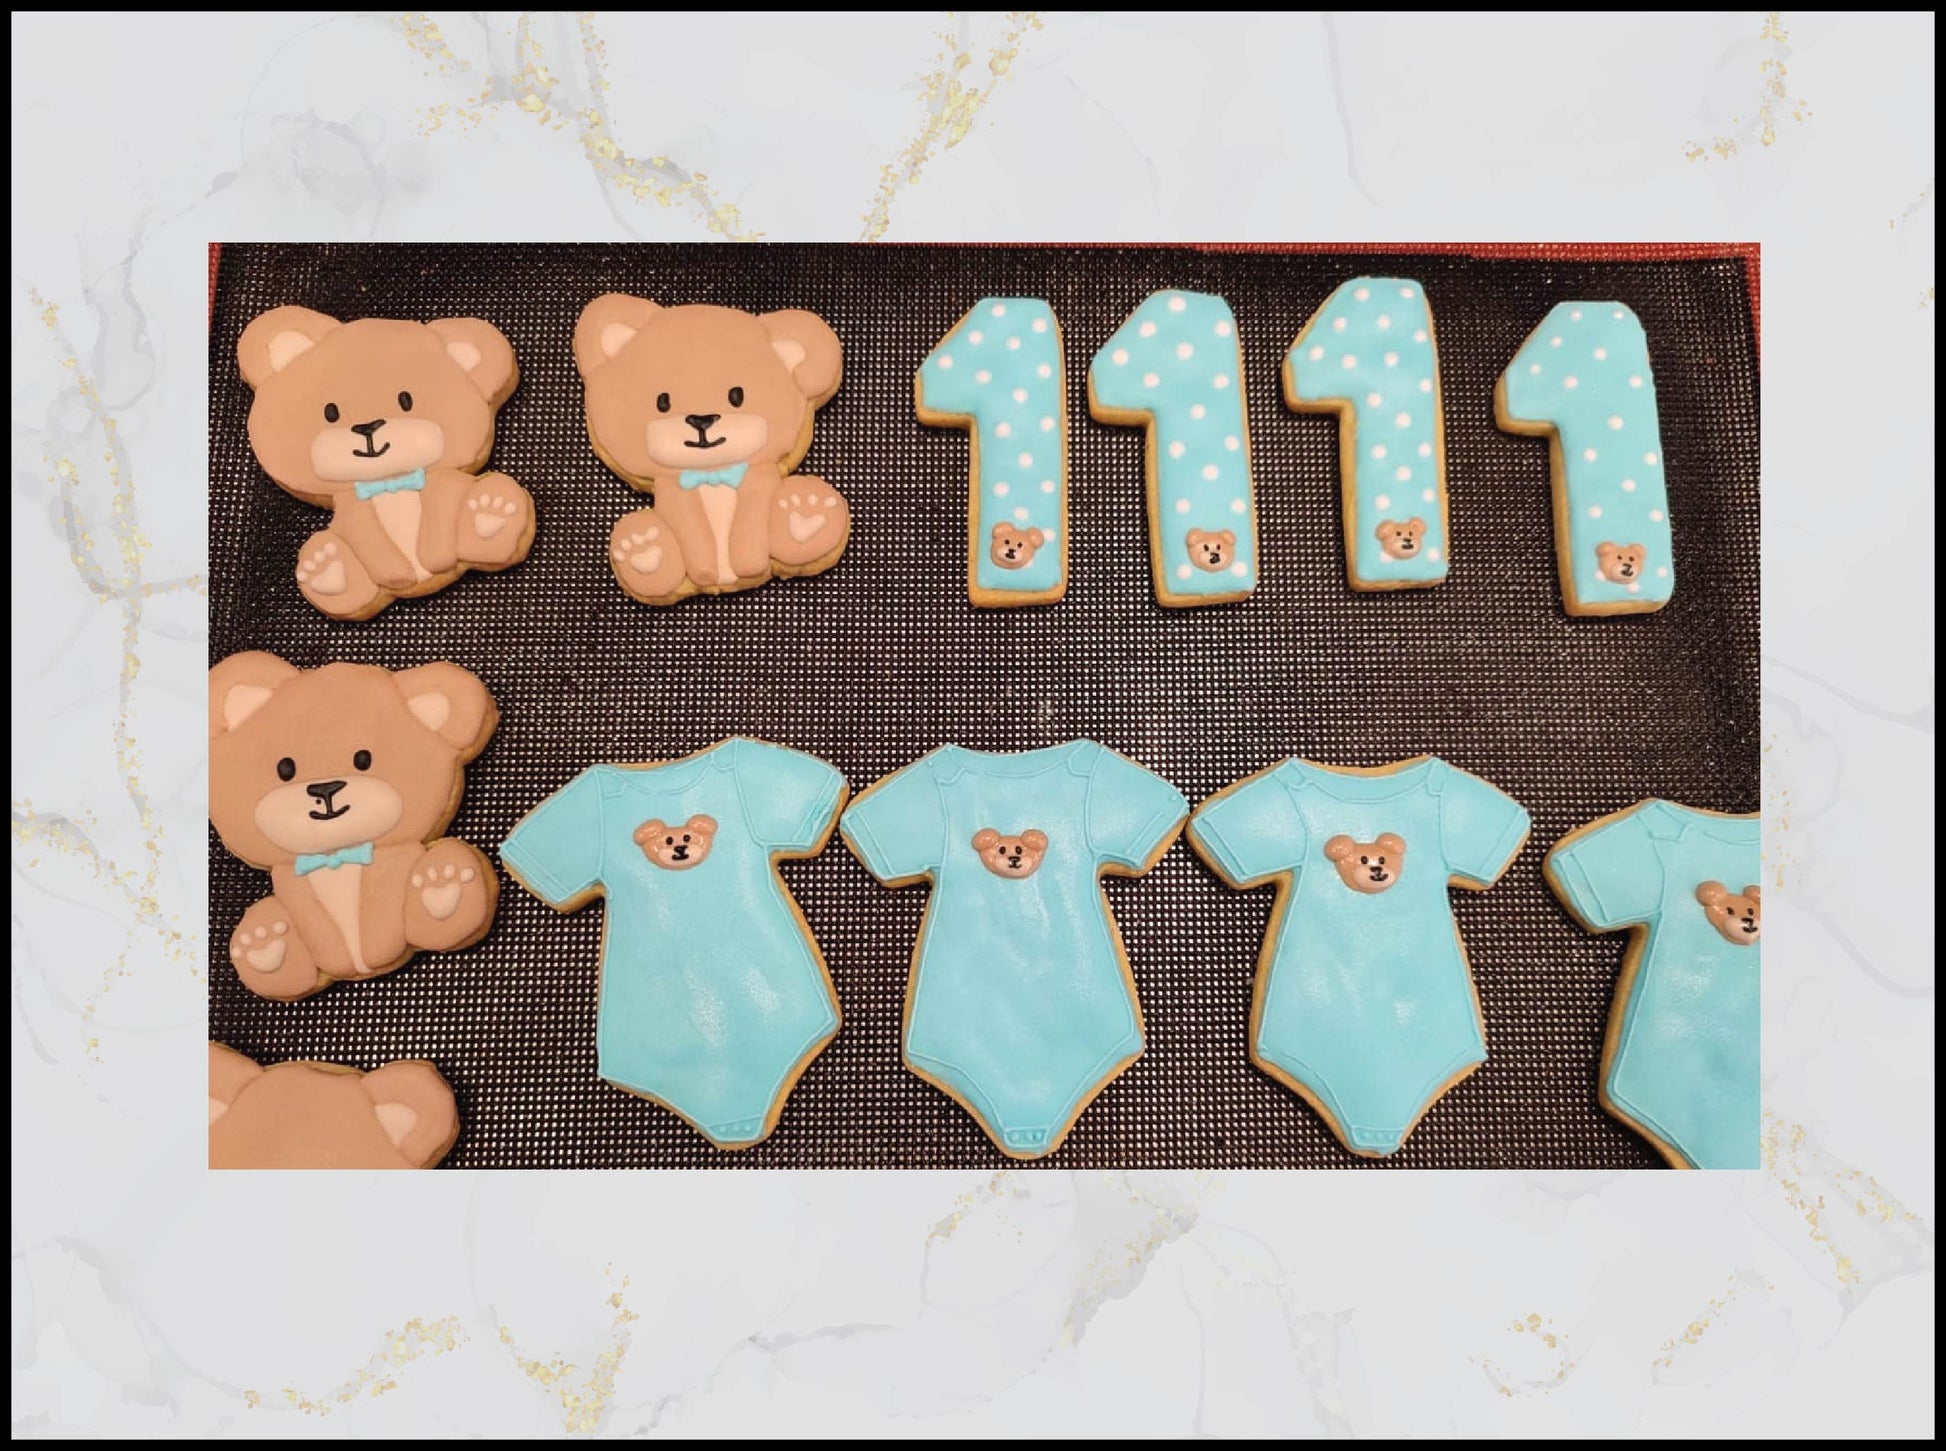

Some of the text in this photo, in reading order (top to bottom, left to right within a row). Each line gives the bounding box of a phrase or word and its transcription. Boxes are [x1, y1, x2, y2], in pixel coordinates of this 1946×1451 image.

[915, 297, 1067, 607] 1
[1088, 289, 1258, 608] 1
[1283, 276, 1449, 591] 1
[1494, 300, 1674, 616] 1
